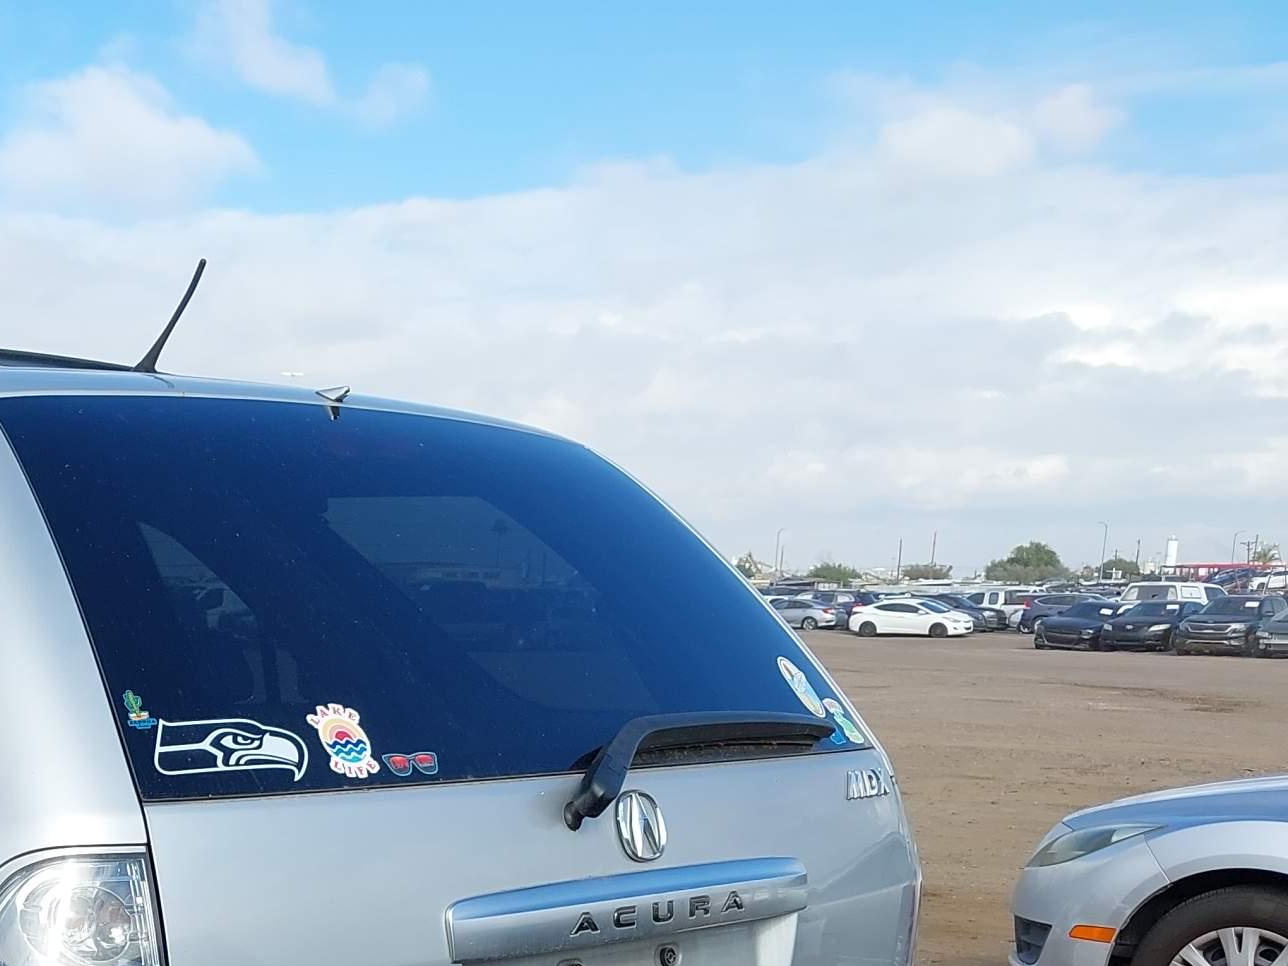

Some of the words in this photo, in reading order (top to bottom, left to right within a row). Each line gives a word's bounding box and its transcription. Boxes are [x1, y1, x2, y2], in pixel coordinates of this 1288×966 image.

[310, 706, 357, 726] LAKE
[333, 760, 376, 776] LIFE
[846, 767, 890, 800] MDX
[570, 890, 745, 937] ACURA
